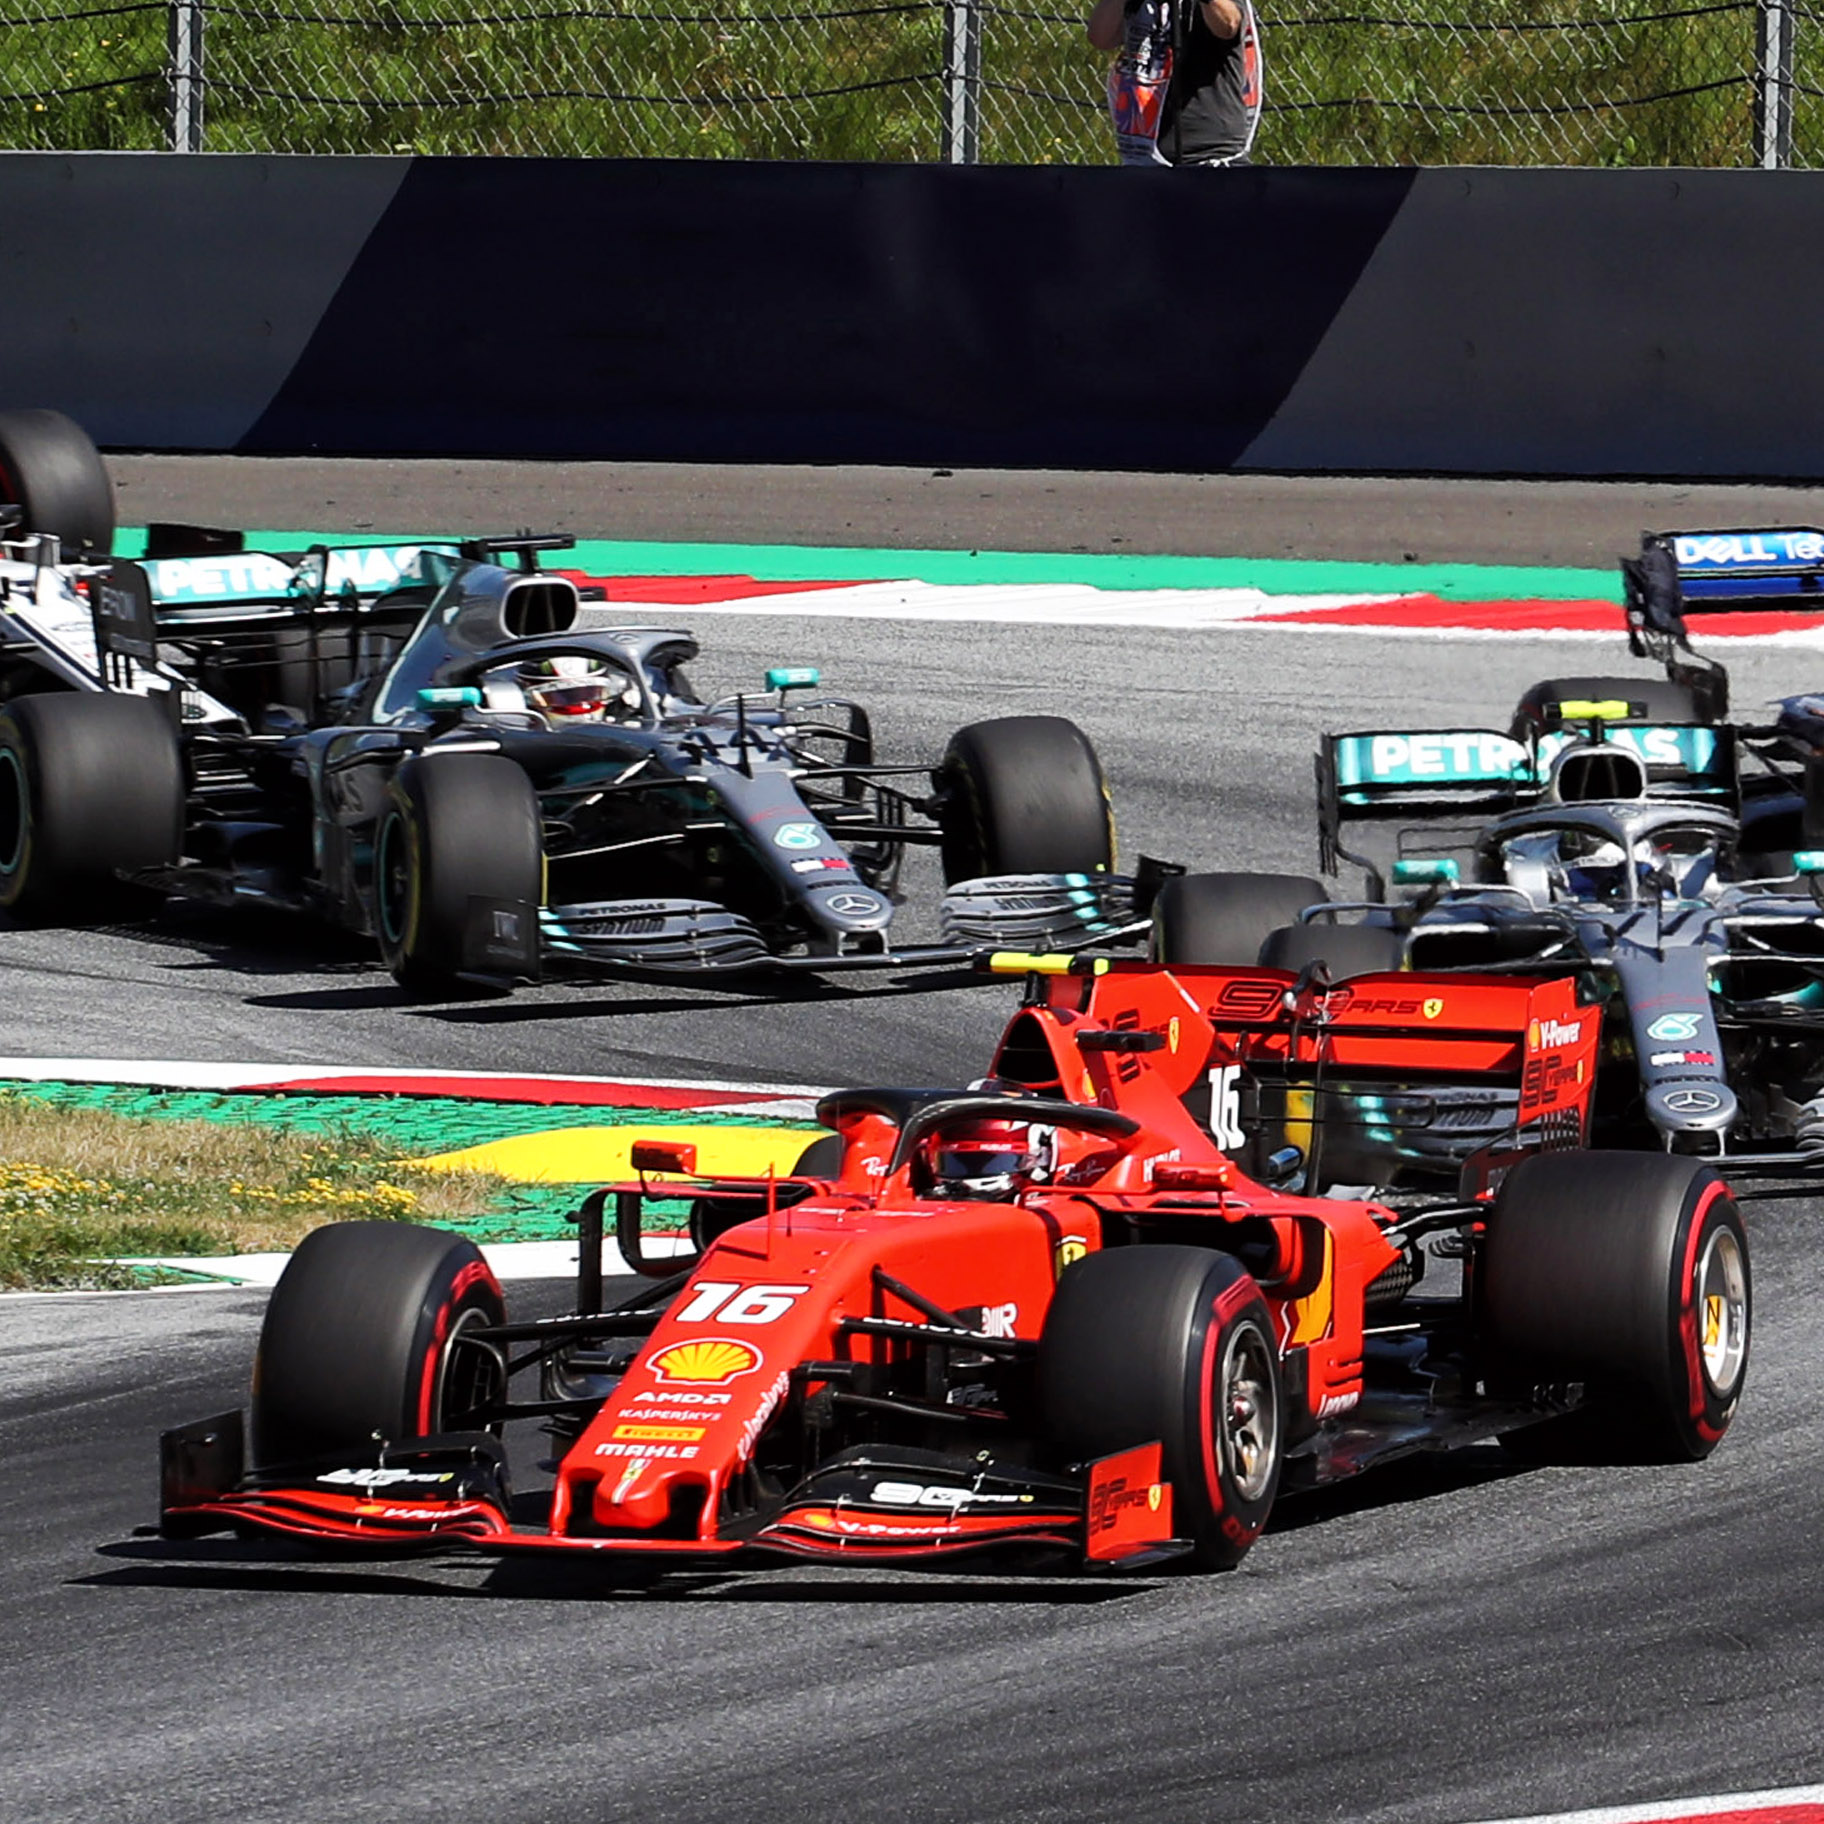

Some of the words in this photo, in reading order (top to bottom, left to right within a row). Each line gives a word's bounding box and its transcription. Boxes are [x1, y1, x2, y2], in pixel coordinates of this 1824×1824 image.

[1677, 535, 1777, 564] DELL
[157, 546, 424, 596] PETRNAS
[579, 902, 667, 915] PETRONAS
[1208, 1064, 1247, 1152] 16
[675, 1281, 812, 1325] 16
[632, 1391, 706, 1405] AMD
[594, 1443, 700, 1459] MAHLE
